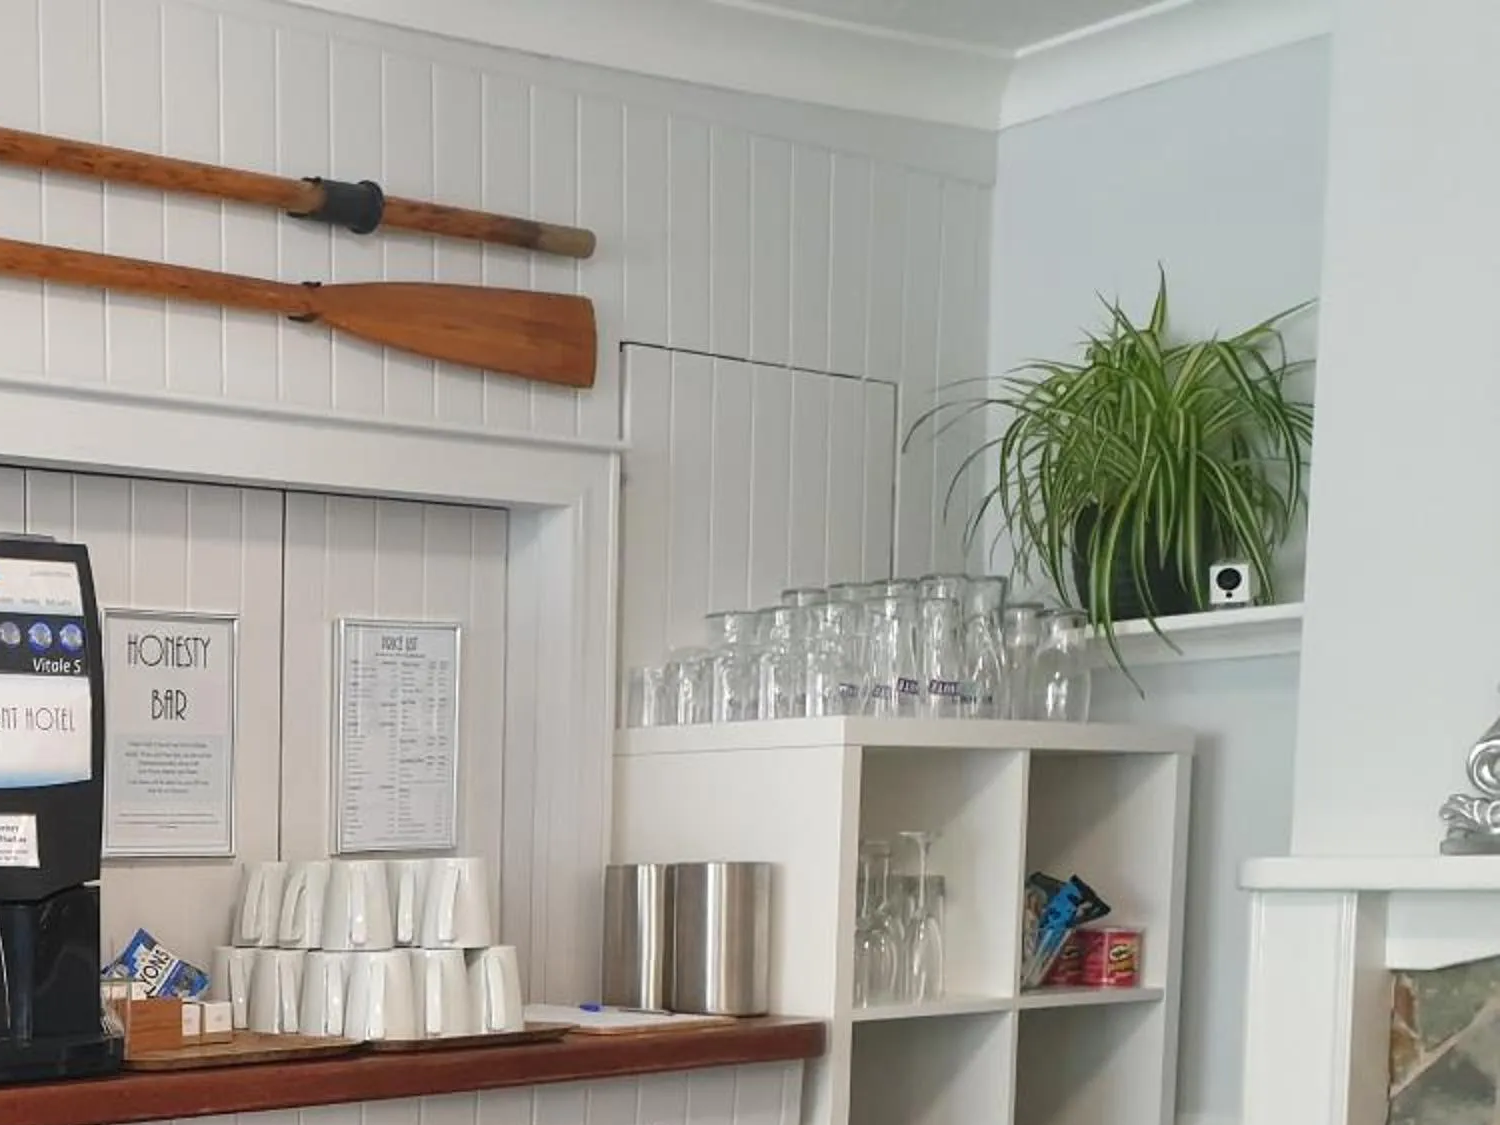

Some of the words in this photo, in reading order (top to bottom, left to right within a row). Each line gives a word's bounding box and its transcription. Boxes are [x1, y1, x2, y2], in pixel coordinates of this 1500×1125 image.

[127, 633, 211, 668] HONESTY
[32, 657, 70, 674] Vitale
[72, 659, 82, 673] S
[151, 689, 188, 720] BAR
[25, 706, 76, 732] HOTEL
